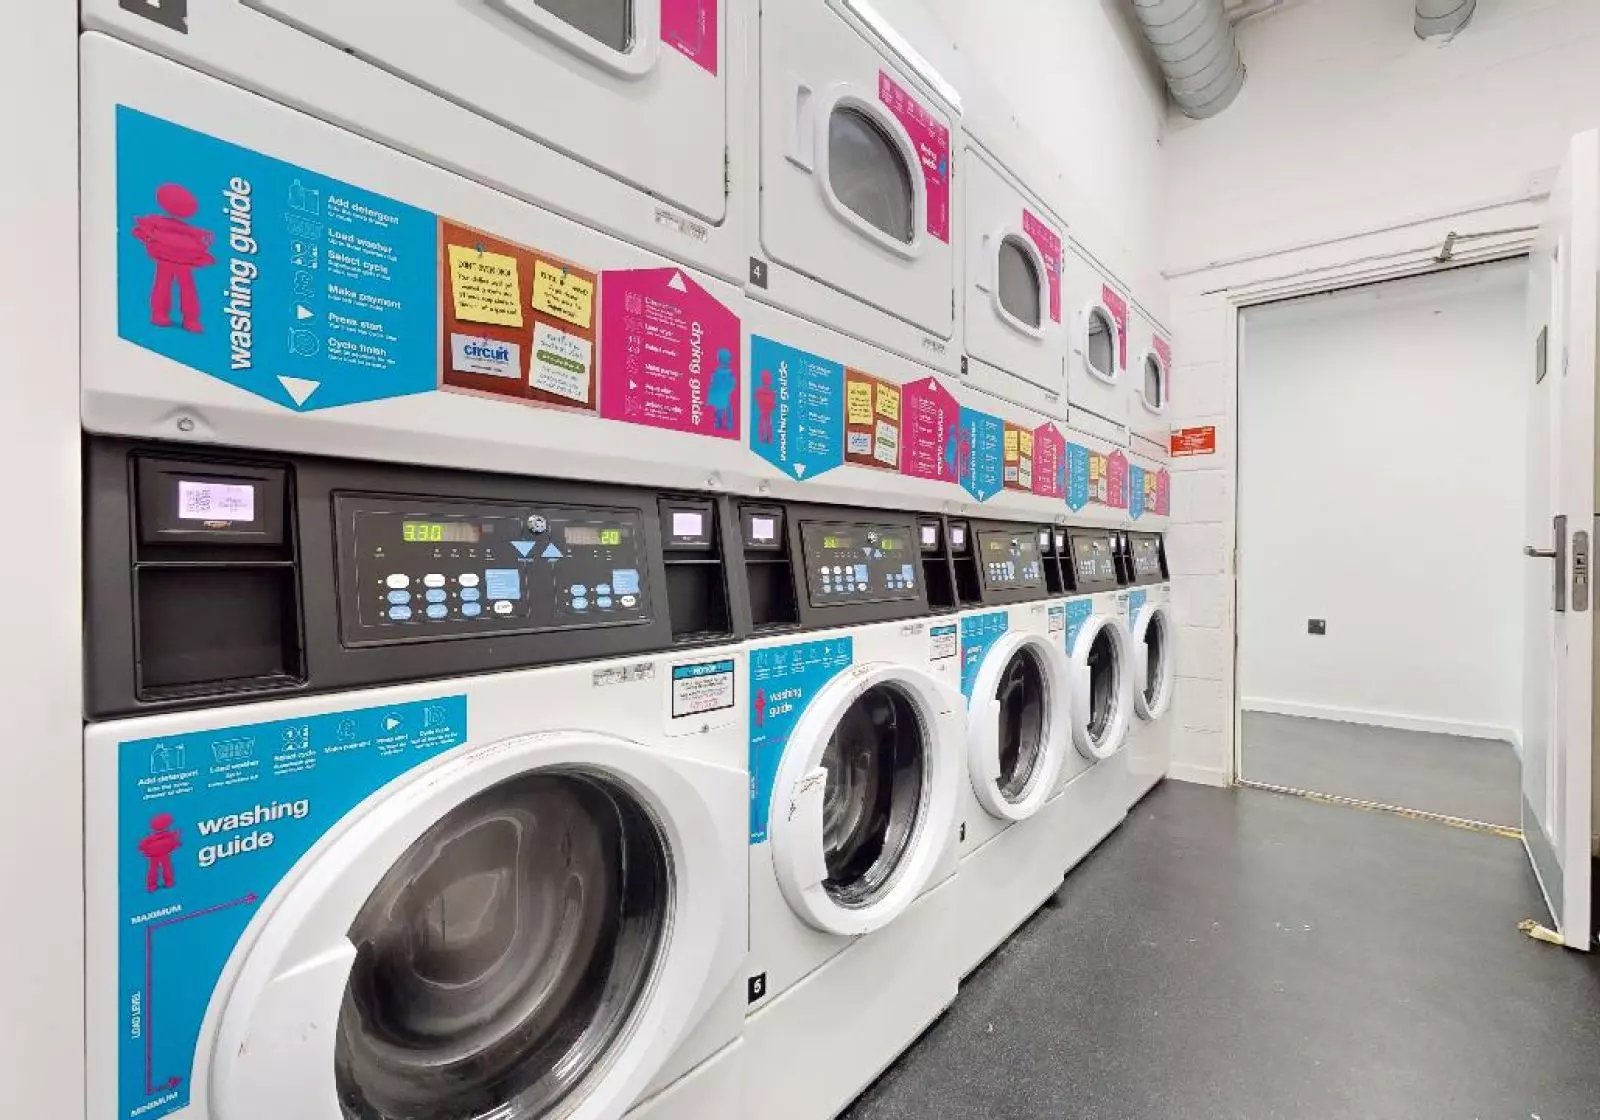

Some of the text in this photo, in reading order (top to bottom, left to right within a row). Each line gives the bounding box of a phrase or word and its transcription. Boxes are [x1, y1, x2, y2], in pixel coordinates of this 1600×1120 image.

[328, 195, 349, 209] Add
[351, 203, 399, 225] detergent
[328, 228, 354, 242] Load
[357, 238, 393, 254] washer
[222, 175, 258, 370] washing guide
[328, 250, 360, 267] Select
[363, 261, 388, 275] cycle
[328, 283, 357, 298] Make
[358, 293, 401, 310] payment
[328, 312, 357, 326] Press
[361, 321, 383, 332] start
[328, 337, 387, 357] Cycle finish
[464, 342, 509, 361] circuit
[689, 321, 704, 425] drying guide
[778, 360, 789, 462] washing guide
[601, 531, 619, 545] 20
[769, 687, 802, 703] washing
[769, 701, 793, 718] guide
[274, 749, 317, 761] Select cycle
[324, 746, 343, 754] Make
[343, 740, 371, 751] payment
[137, 777, 156, 787] Add
[157, 769, 198, 783] detergent
[209, 760, 259, 774] Load washer
[197, 799, 310, 837] washing
[198, 831, 275, 868] guide
[130, 904, 182, 925] MAXIMUM
[131, 990, 141, 1040] LOAD LEVEL
[130, 1091, 178, 1118] MINIMUM
